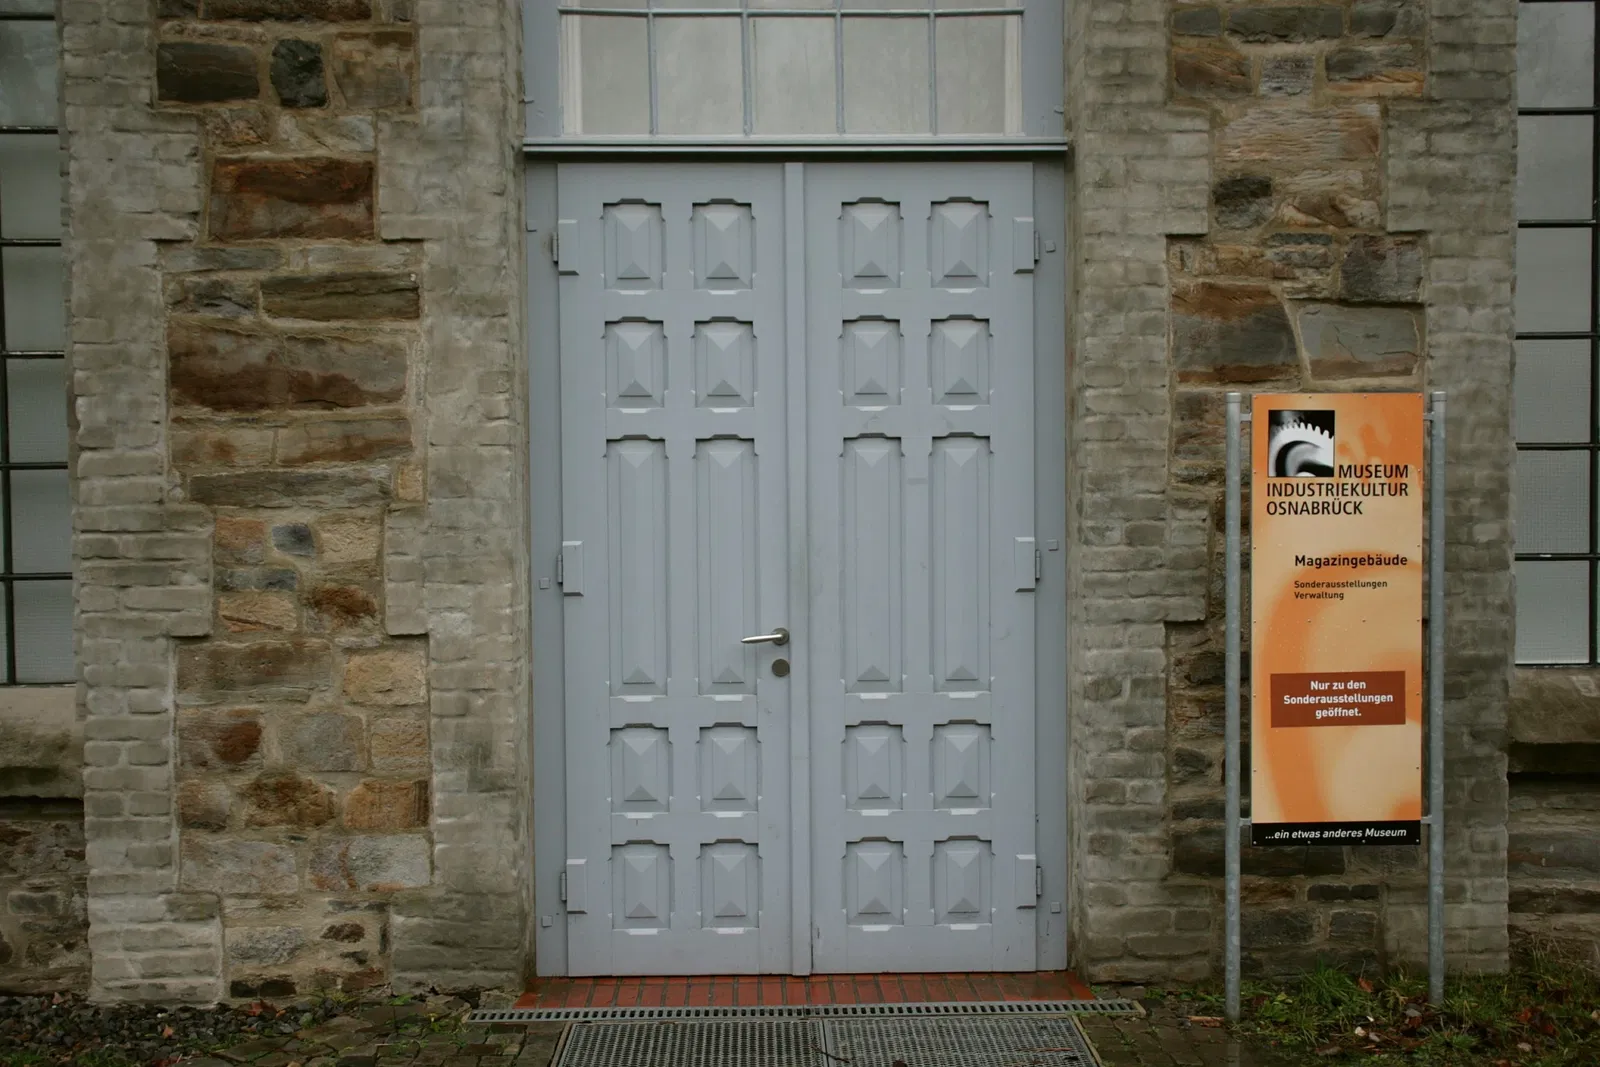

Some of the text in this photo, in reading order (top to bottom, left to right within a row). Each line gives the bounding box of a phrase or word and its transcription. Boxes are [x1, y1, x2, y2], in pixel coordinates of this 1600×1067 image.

[1338, 464, 1409, 479] MUSEUM
[1266, 482, 1409, 497] INDUSTRIEKULTUR
[1266, 498, 1363, 516] OSNABRÜCK
[1294, 554, 1408, 569] Magazingebäude
[1294, 580, 1388, 589] Sonderausstellungen
[1294, 591, 1344, 600] Verwaltung
[1310, 680, 1366, 690] Nur zu den
[1283, 693, 1393, 705] Sonderausstellungen
[1315, 707, 1361, 719] geöffnet.
[1291, 829, 1320, 839] etwas
[1322, 828, 1362, 838] anderes
[1365, 828, 1407, 837] Museum
